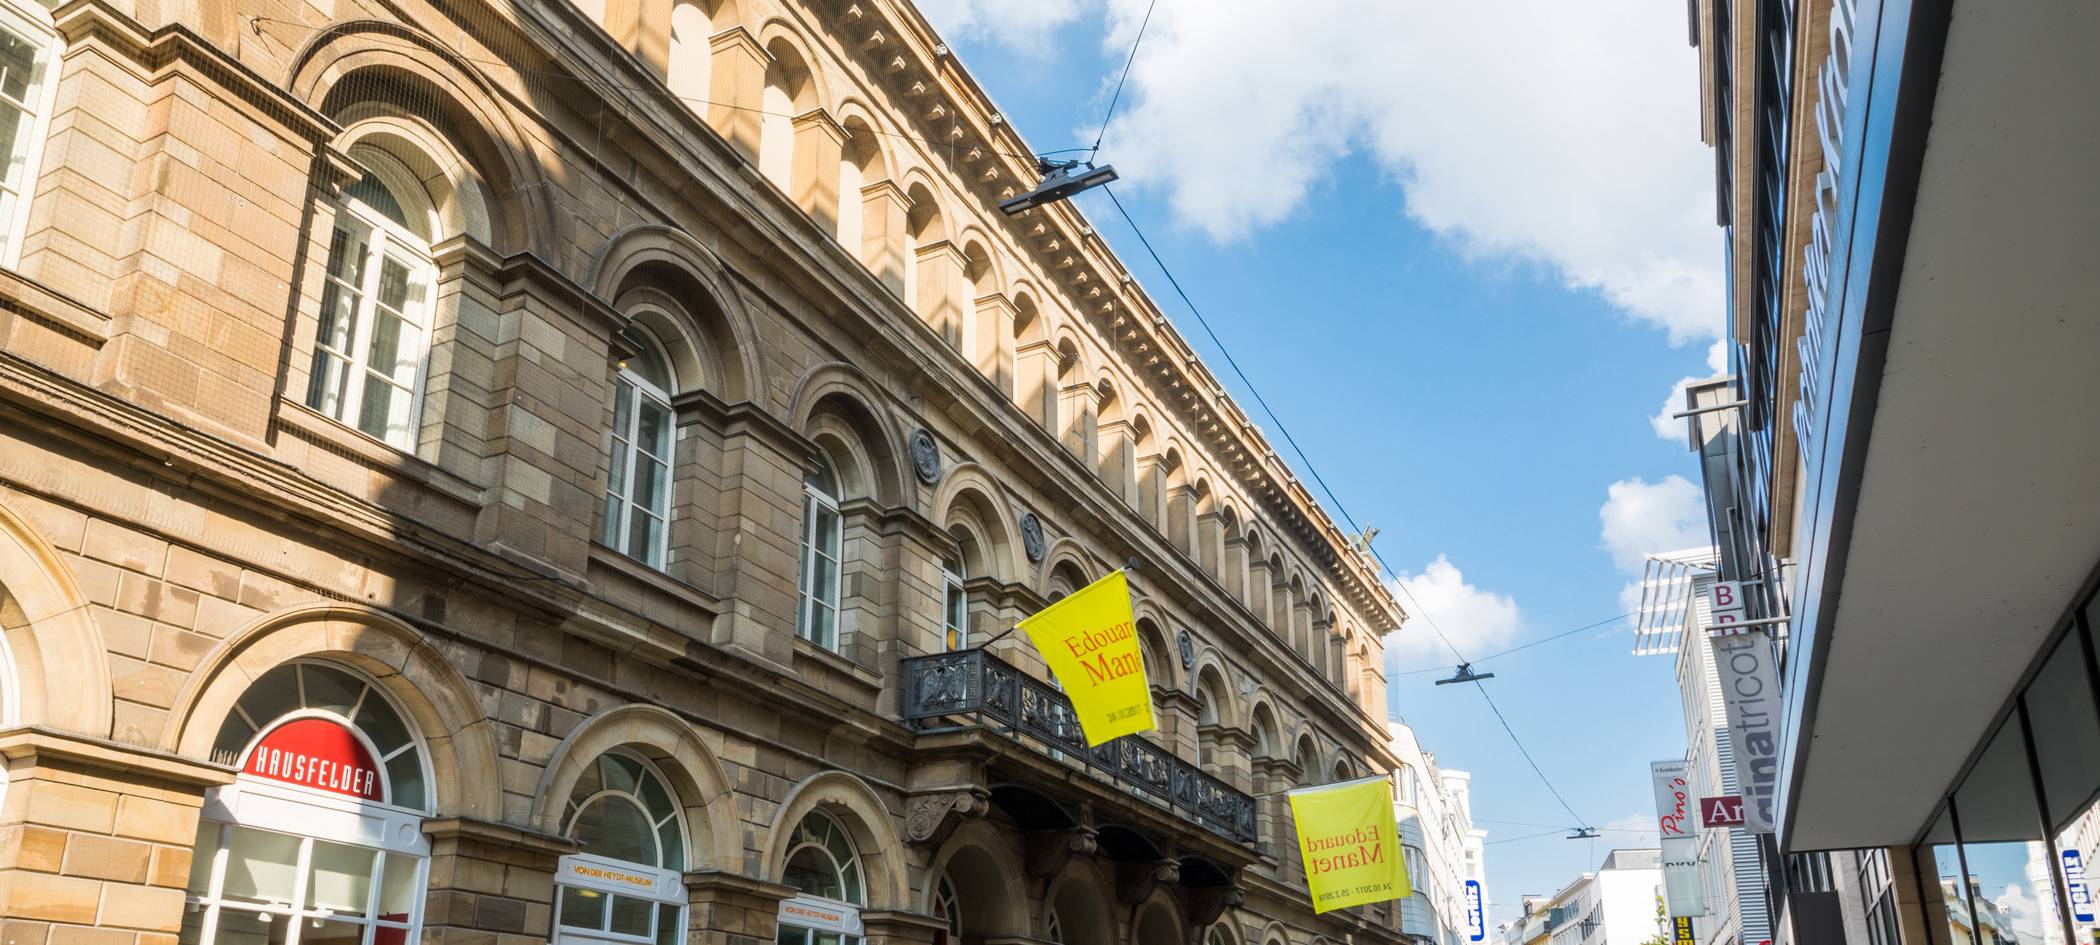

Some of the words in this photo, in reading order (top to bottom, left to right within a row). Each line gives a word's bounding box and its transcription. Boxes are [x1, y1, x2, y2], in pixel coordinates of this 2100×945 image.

[1064, 620, 1134, 659] Edouar
[255, 745, 374, 796] HAUSFELDER
[1661, 778, 1686, 835] Pino's
[574, 865, 590, 876] VON
[591, 868, 602, 878] DER
